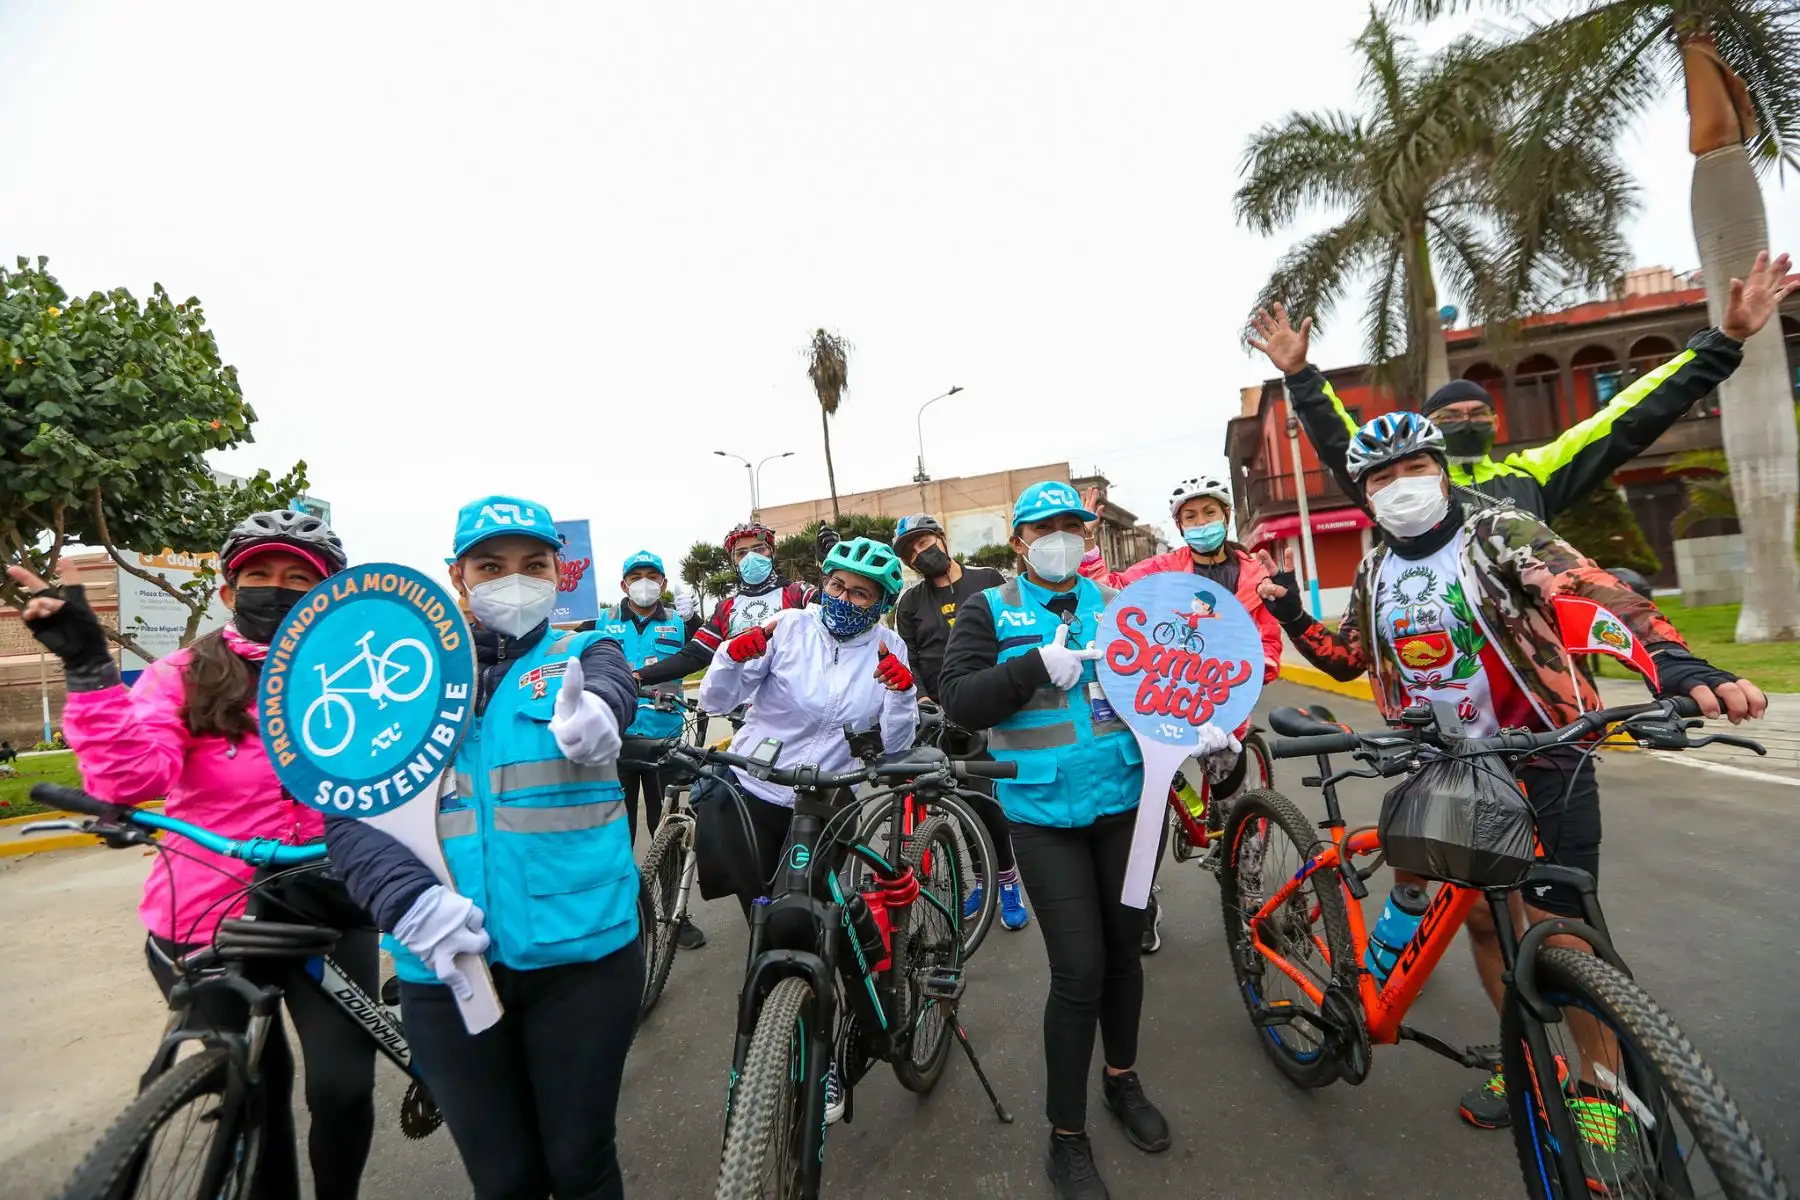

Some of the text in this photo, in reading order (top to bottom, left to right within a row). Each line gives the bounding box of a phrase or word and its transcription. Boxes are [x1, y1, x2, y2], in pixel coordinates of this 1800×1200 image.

[474, 503, 536, 529] ATU
[265, 572, 460, 768] PROMOVIENDO LA MOVILIDAD
[1106, 606, 1252, 705] Somos
[1134, 671, 1215, 727] bici
[314, 682, 469, 812] SOSTENIBLE
[333, 987, 409, 1058] DOWNHILL
